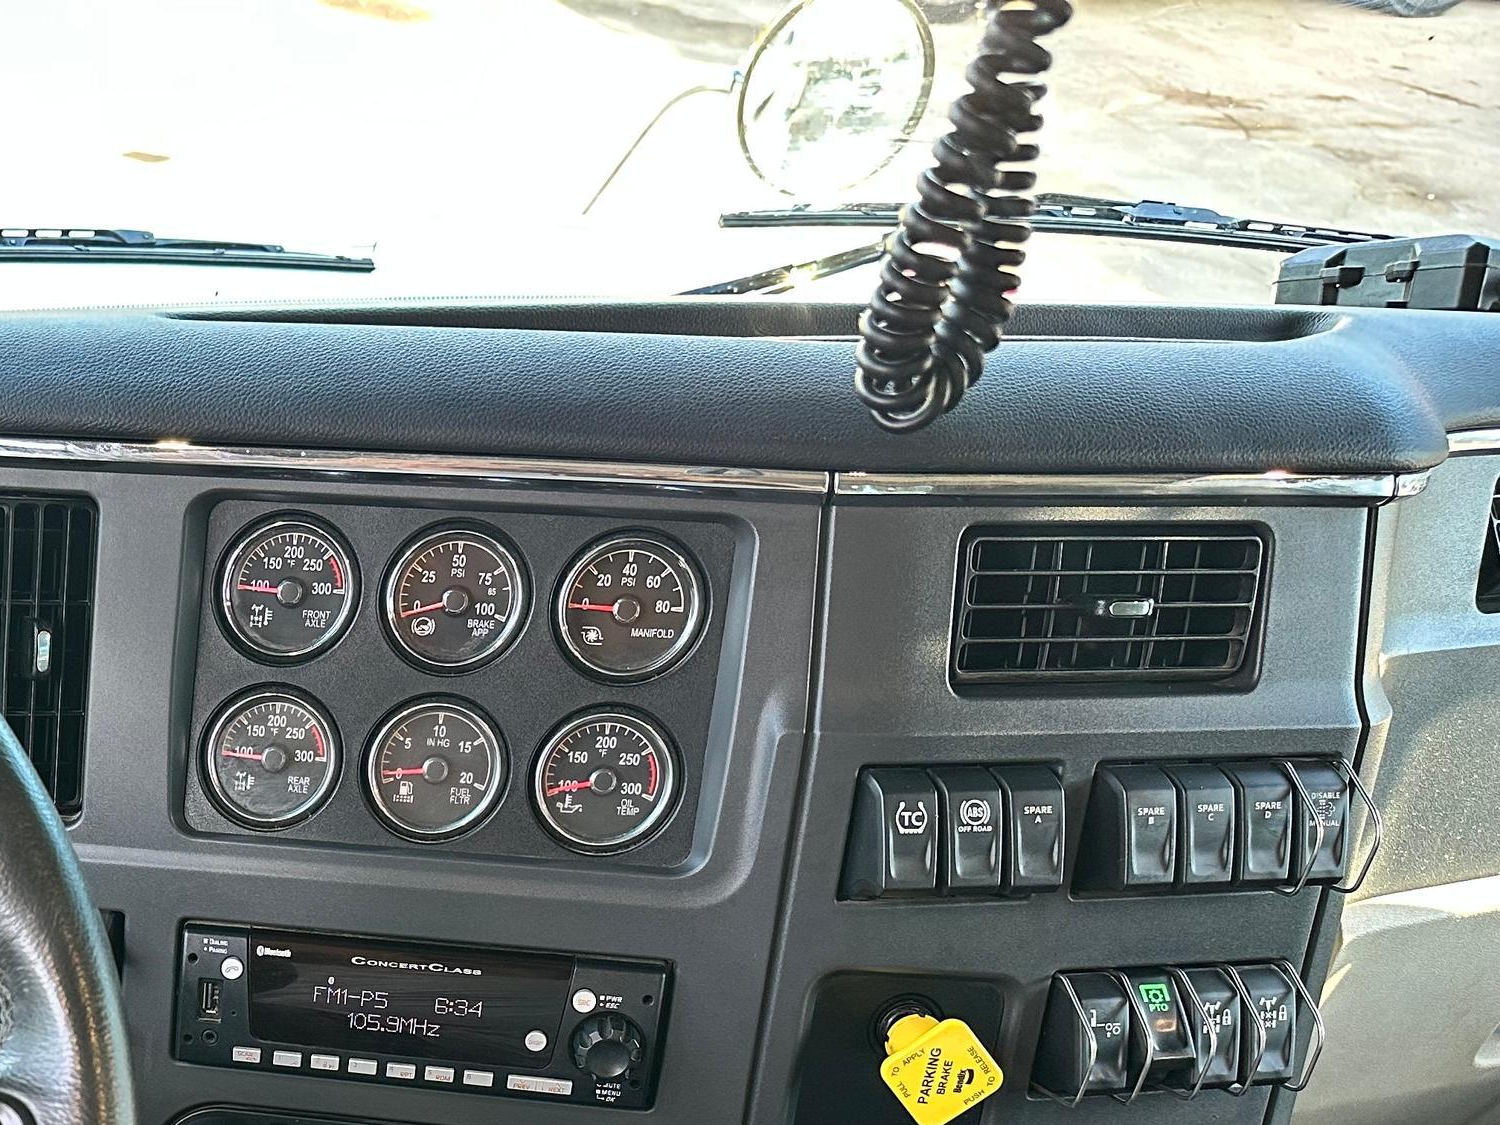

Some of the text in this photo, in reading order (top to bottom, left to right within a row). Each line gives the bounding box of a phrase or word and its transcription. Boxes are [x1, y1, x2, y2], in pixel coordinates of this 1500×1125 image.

[284, 546, 304, 559] 200
[263, 557, 283, 570] 150
[303, 558, 323, 571] 250
[452, 554, 467, 568] 50
[451, 569, 465, 578] PSI
[622, 563, 638, 576] 40
[421, 571, 436, 583] 25
[478, 572, 493, 586] 75
[596, 574, 612, 587] 20
[620, 577, 636, 587] PSI
[646, 575, 661, 589] 60
[312, 582, 332, 595] 300
[474, 602, 495, 616] 100
[655, 600, 670, 614] 80
[302, 610, 331, 620] FRONT
[305, 619, 326, 628] AXLE
[467, 619, 495, 629] BRAKE
[471, 628, 489, 637] APP
[630, 628, 674, 639] MANIFOLD
[267, 715, 287, 727] 200
[246, 724, 266, 737] 150
[285, 727, 305, 740] 250
[433, 725, 447, 737] 10
[404, 738, 412, 750] 5
[426, 739, 451, 748] IN HG
[458, 741, 472, 753] 15
[594, 736, 618, 749] 200
[294, 750, 314, 762] 300
[567, 751, 588, 764] 150
[618, 753, 640, 766] 250
[287, 776, 310, 785] REAR
[459, 772, 474, 784] 20
[287, 785, 309, 794] AXLE
[450, 787, 471, 796] FUEL
[620, 782, 642, 795] 300
[449, 795, 470, 805] FLTR
[1311, 792, 1340, 800] DISABLE
[620, 799, 634, 808] OIL
[1197, 804, 1224, 813] SPARE
[1255, 801, 1282, 810] SPARE
[616, 807, 640, 816] TEMP
[967, 807, 984, 818] ABS
[1023, 805, 1053, 815] SPARE
[1137, 807, 1165, 816] SPARE
[1265, 811, 1271, 819] D
[900, 811, 923, 826] TC
[1034, 815, 1042, 824] A
[1148, 816, 1155, 825] B
[1208, 813, 1214, 822] C
[312, 986, 389, 1009] FM1-P5
[435, 997, 483, 1018] 6:34
[1149, 1003, 1169, 1012] PTO
[347, 1012, 440, 1037] 105.9MHz
[902, 1048, 926, 1066] APPLY
[967, 1046, 991, 1075] RELEASE
[891, 1066, 900, 1077] TO
[917, 1047, 942, 1104] PARKING
[936, 1060, 953, 1095] BRAKE
[953, 1069, 967, 1093] Bendix
[987, 1076, 996, 1087] TO
[602, 1089, 621, 1097] MENU
[899, 1081, 911, 1098] PULL
[963, 1089, 986, 1105] PUSH
